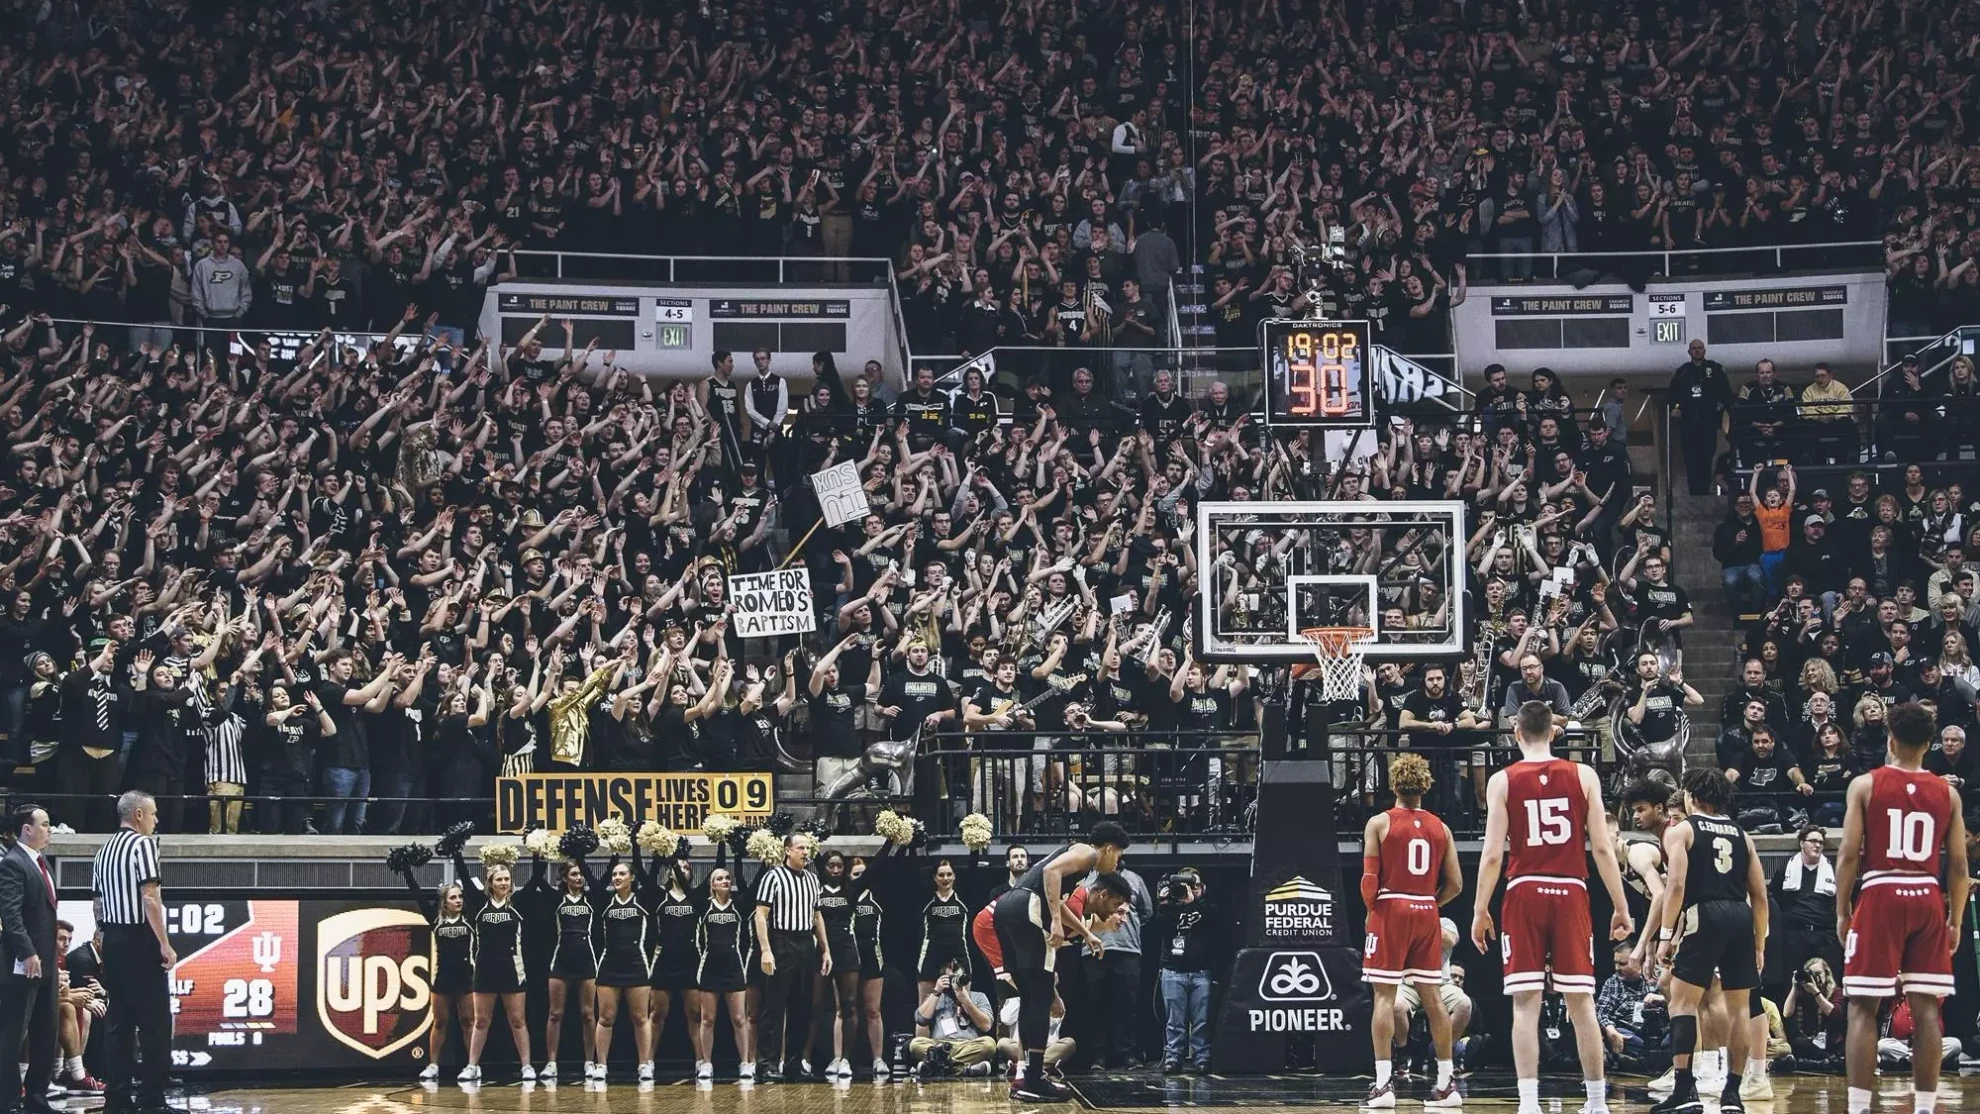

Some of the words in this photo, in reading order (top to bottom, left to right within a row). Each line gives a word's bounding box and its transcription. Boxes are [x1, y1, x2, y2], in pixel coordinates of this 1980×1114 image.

[507, 207, 520, 217] 21
[530, 299, 543, 309] THE
[550, 299, 579, 310] PAINT
[581, 300, 609, 311] CREW
[1734, 295, 1752, 305] THE
[1754, 293, 1784, 304] PAINT
[1786, 291, 1816, 302] CREW
[740, 304, 757, 314] THE
[760, 304, 788, 314] PAINT
[791, 304, 820, 314] CREW
[1522, 301, 1539, 311] THE
[1542, 300, 1570, 311] PAINT
[1574, 300, 1602, 310] CREW
[1658, 304, 1676, 313] 5-6
[665, 309, 683, 319] 4-5
[1069, 320, 1077, 331] 4
[1657, 322, 1679, 341] EXIT
[664, 327, 684, 346] EXIT
[1288, 333, 1357, 359] 19:02
[1291, 364, 1347, 413] 30
[731, 574, 775, 591] TIME
[779, 571, 806, 590] FOR
[733, 590, 808, 613] ROMEO'S
[737, 615, 810, 633] BAPTISM
[656, 778, 710, 802] LIVES
[500, 777, 652, 831] DEFENSE
[656, 803, 710, 830] HERE
[1523, 797, 1572, 846] 15
[1886, 808, 1935, 861] 10
[1408, 838, 1430, 875] 0
[1712, 836, 1733, 874] 3
[820, 897, 848, 908] PURDUE
[561, 905, 590, 916] PURDUE
[608, 907, 639, 920] PURDUE
[664, 905, 693, 917] PURDUE
[932, 905, 961, 917] PURDUE
[1265, 904, 1332, 916] PURDUE
[164, 904, 225, 934] :02
[482, 912, 512, 924] PURDUE
[708, 913, 737, 925] PURDUE
[1265, 917, 1332, 928] FEDERAL
[438, 925, 468, 938] PURDUE
[223, 979, 274, 1017] 28
[326, 955, 431, 1034] ups
[1249, 1008, 1345, 1032] PIONEER
[208, 1032, 246, 1046] FOULS
